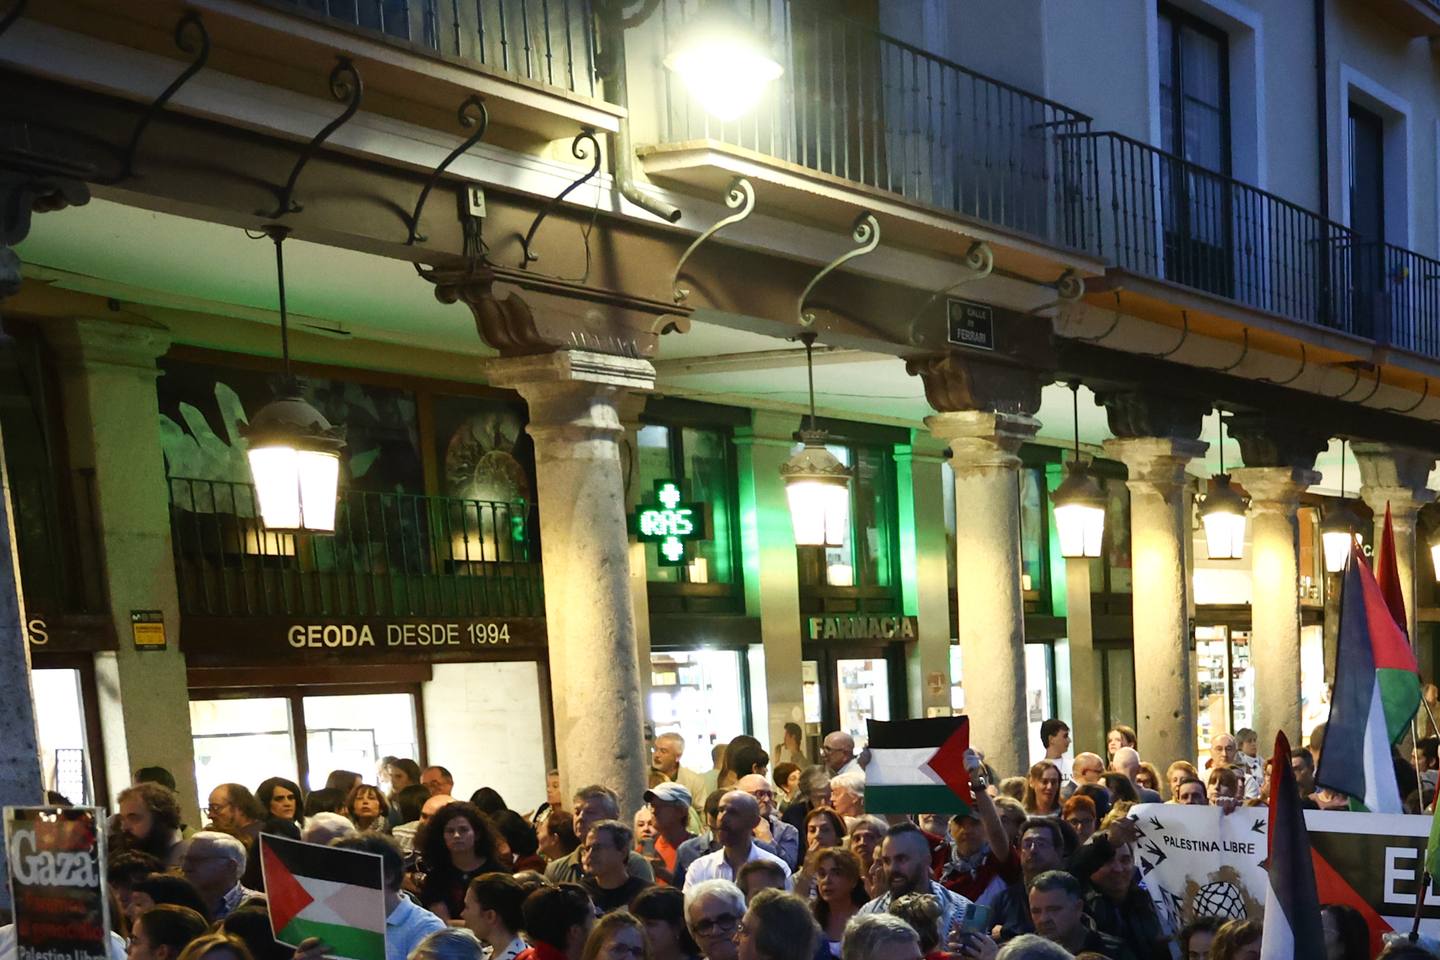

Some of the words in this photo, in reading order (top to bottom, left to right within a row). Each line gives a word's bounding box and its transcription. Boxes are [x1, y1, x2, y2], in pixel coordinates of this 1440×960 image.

[287, 624, 375, 647] GEODA
[387, 623, 460, 646] DESDE
[467, 622, 510, 645] 1994
[808, 616, 914, 640] FARMACIA
[1163, 835, 1220, 853] PALESTINA
[1223, 840, 1256, 855] LIBRE
[11, 829, 99, 888] Gaza
